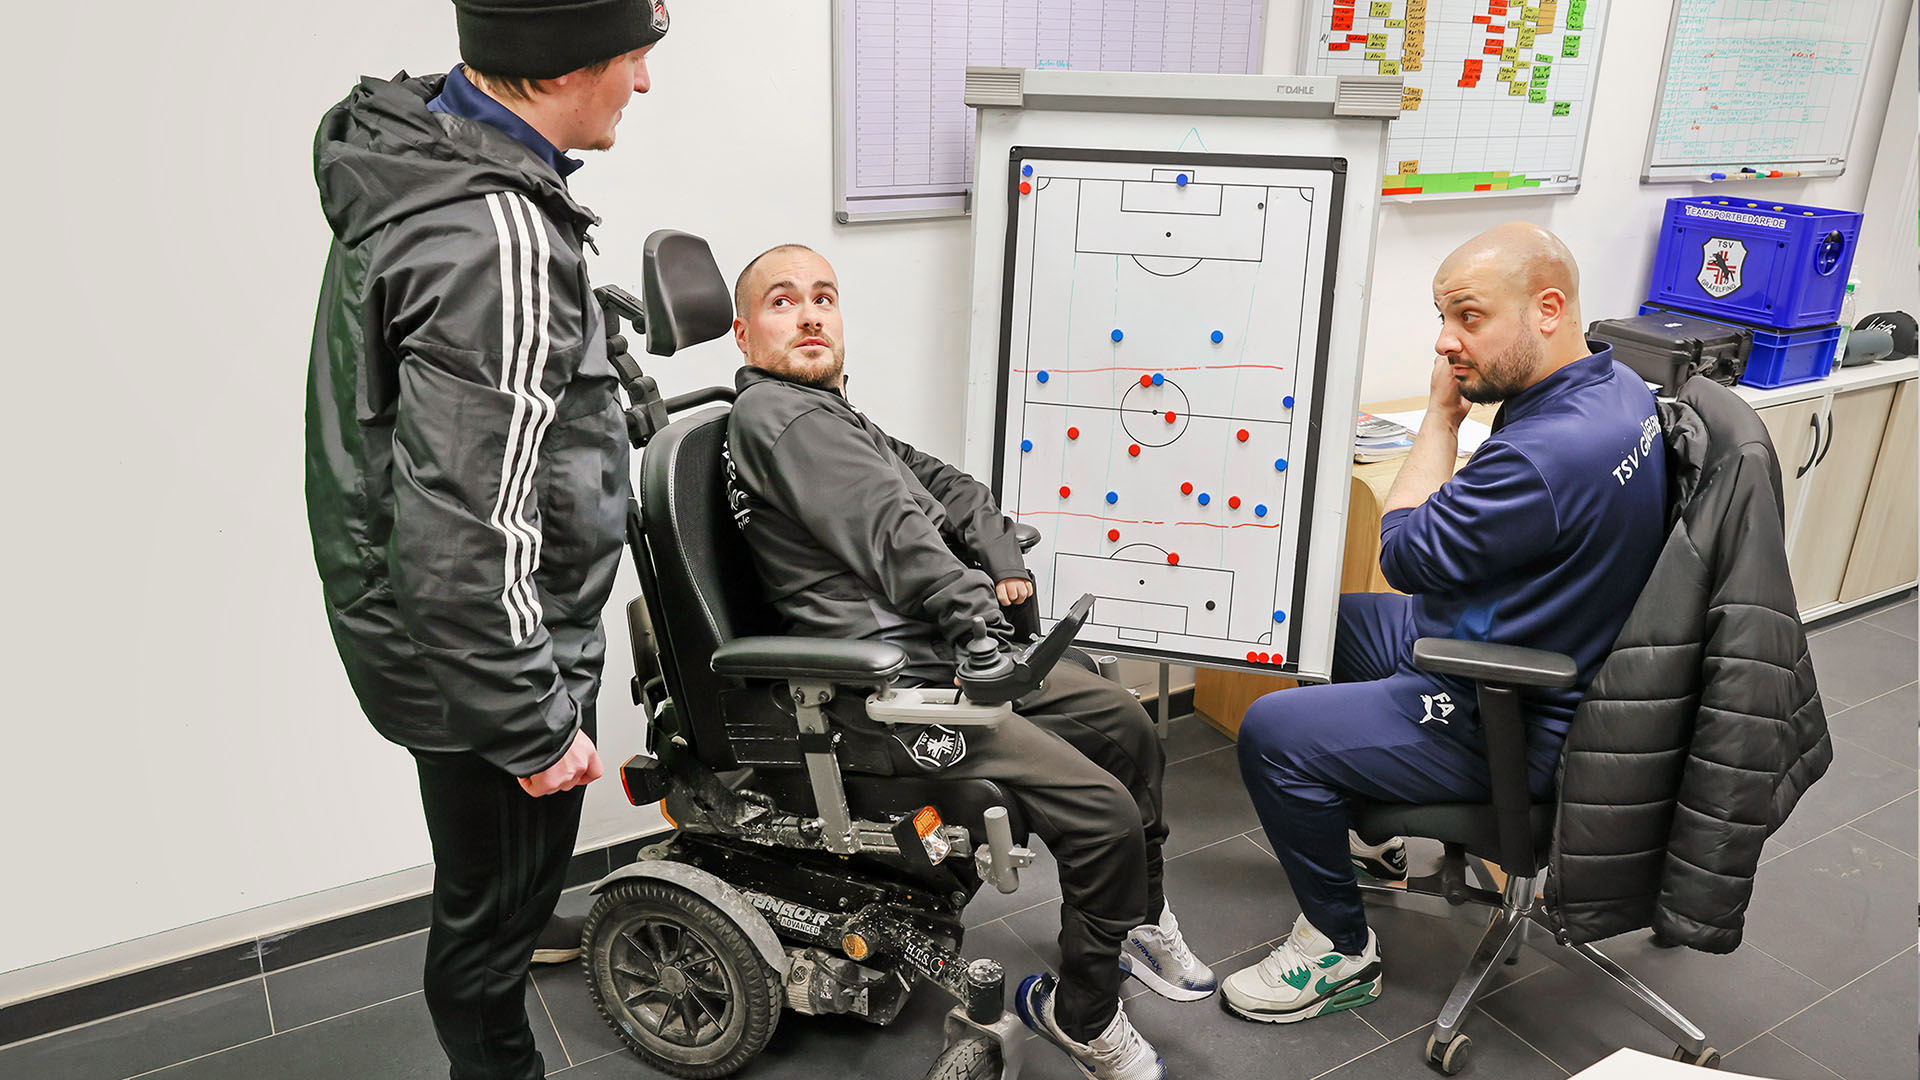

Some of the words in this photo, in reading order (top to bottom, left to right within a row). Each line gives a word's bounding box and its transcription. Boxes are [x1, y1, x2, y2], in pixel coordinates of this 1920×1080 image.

[1285, 85, 1315, 95] DAHLE
[1685, 205, 1786, 229] TEAMSPORTBEDARF.DE
[1717, 240, 1735, 249] TSV
[1612, 447, 1639, 486] TSV
[1432, 692, 1456, 718] FA
[781, 917, 820, 935] ADVANCED
